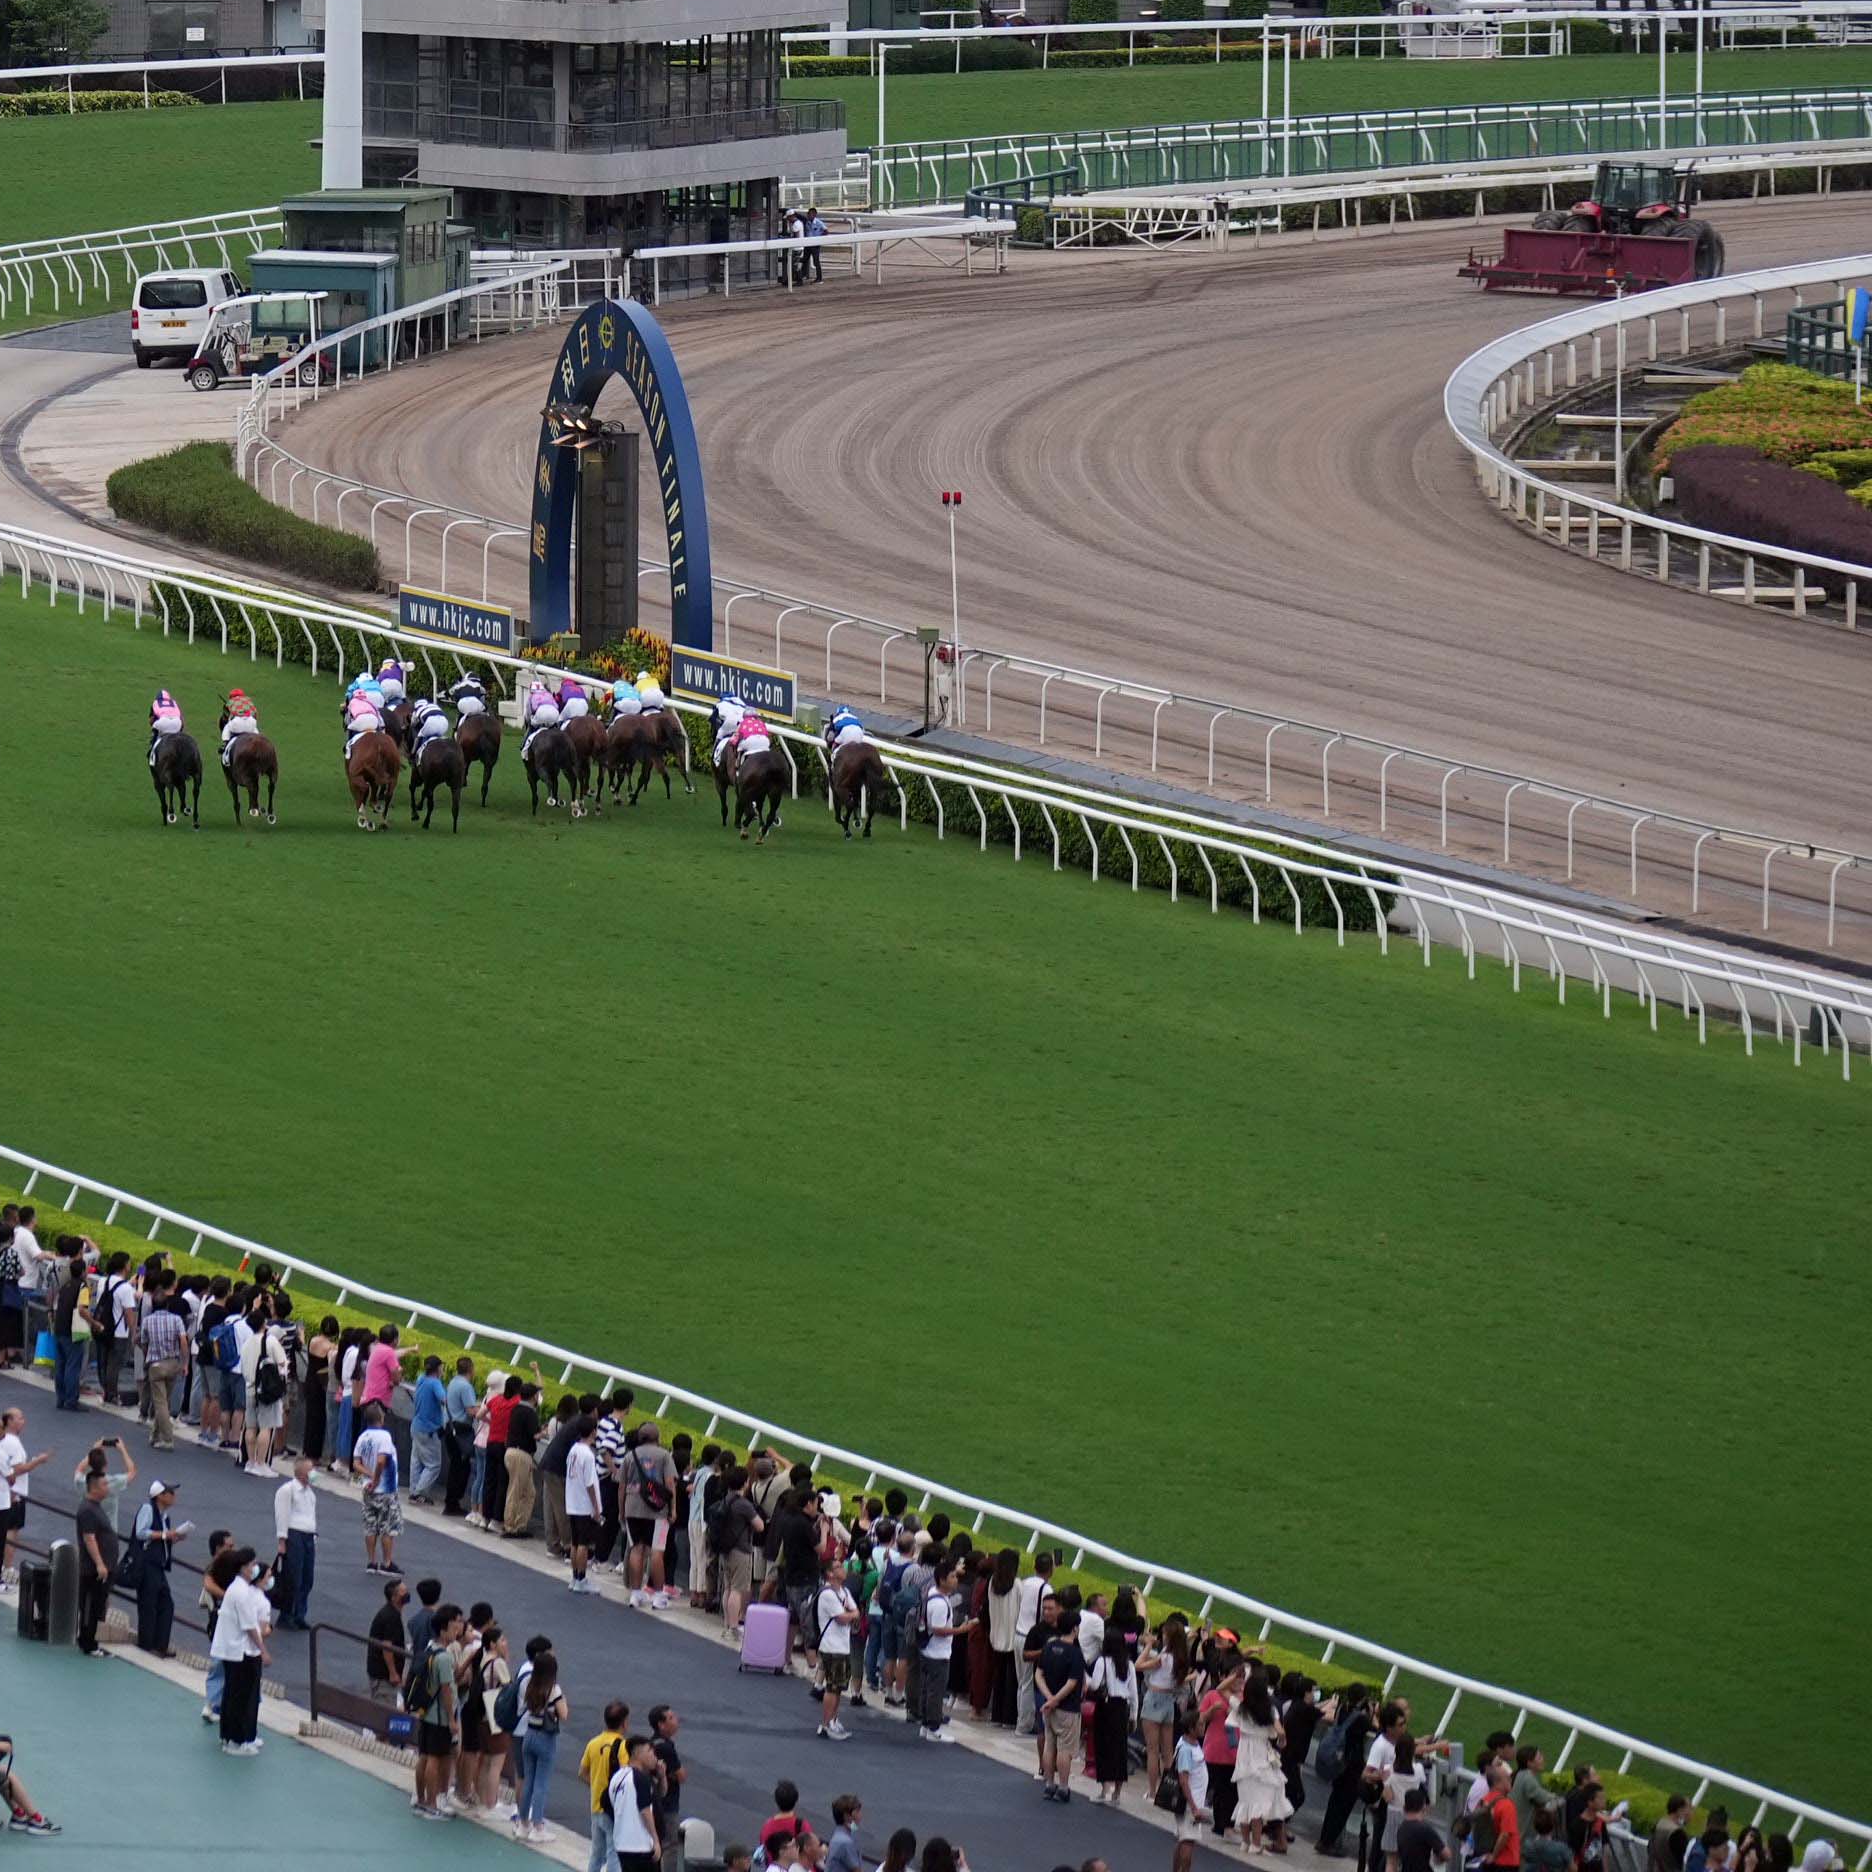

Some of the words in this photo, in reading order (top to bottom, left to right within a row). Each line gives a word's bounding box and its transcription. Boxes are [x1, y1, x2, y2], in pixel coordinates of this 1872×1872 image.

[625, 331, 668, 449] SEASON
[661, 454, 687, 601] FINALE
[408, 599, 503, 642] www.hkjc.com
[682, 660, 784, 709] www.hkjc.com
